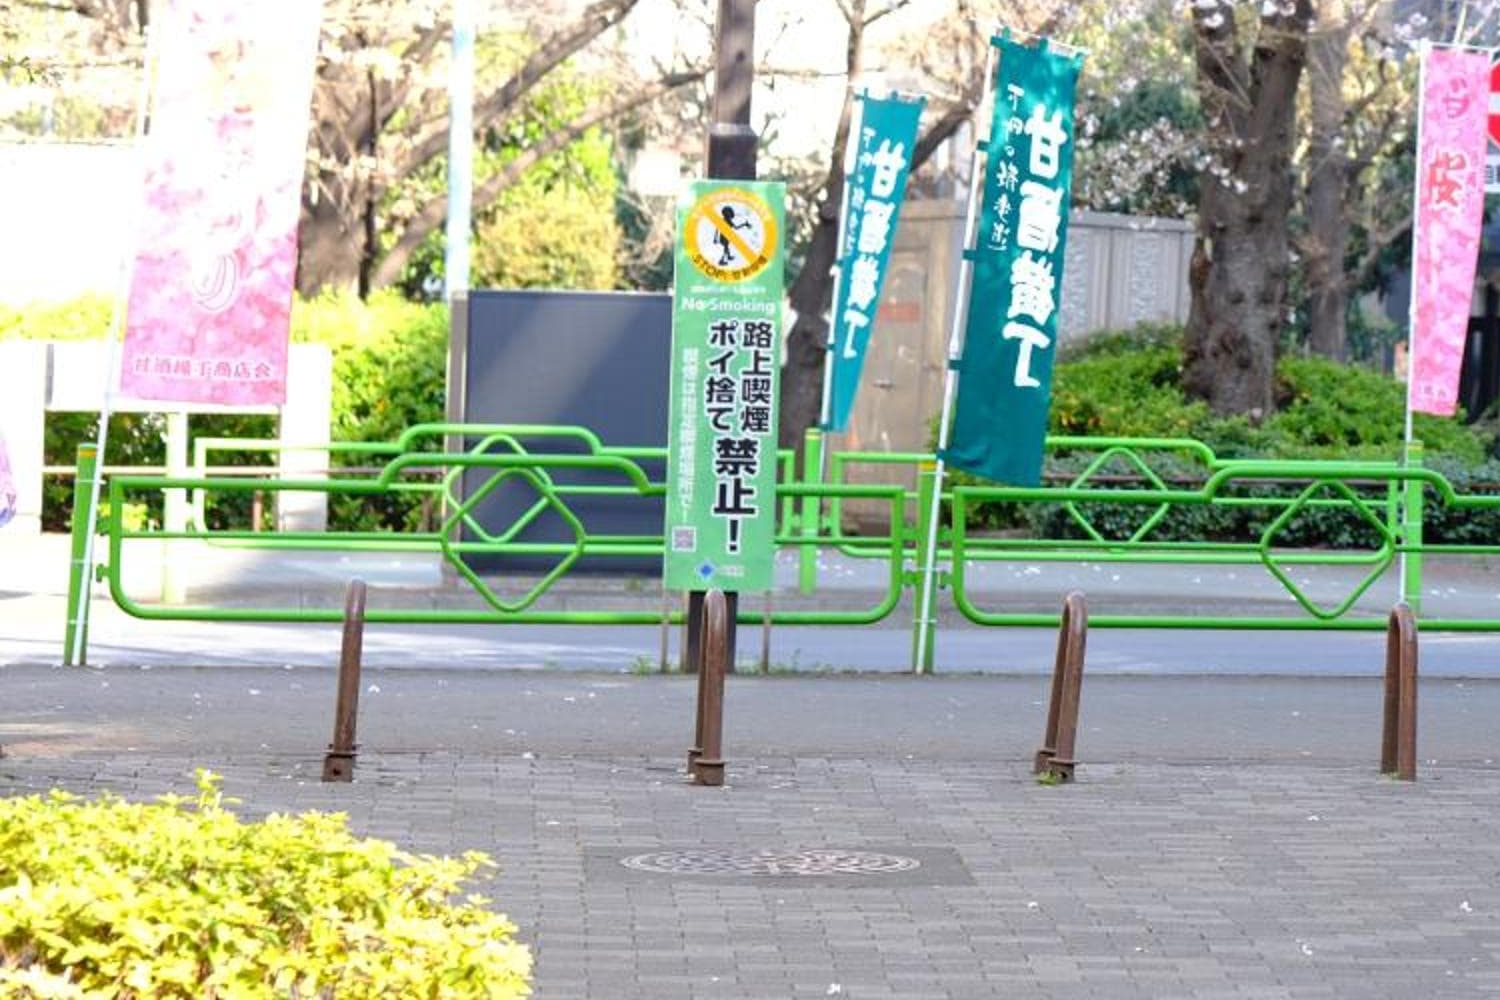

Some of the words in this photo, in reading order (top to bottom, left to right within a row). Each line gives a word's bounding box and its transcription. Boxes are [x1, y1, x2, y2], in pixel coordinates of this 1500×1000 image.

[683, 297, 705, 311] No
[708, 298, 776, 315] Smoking
[705, 320, 739, 431] ポイ捨て
[741, 321, 773, 433] 路上喫煙
